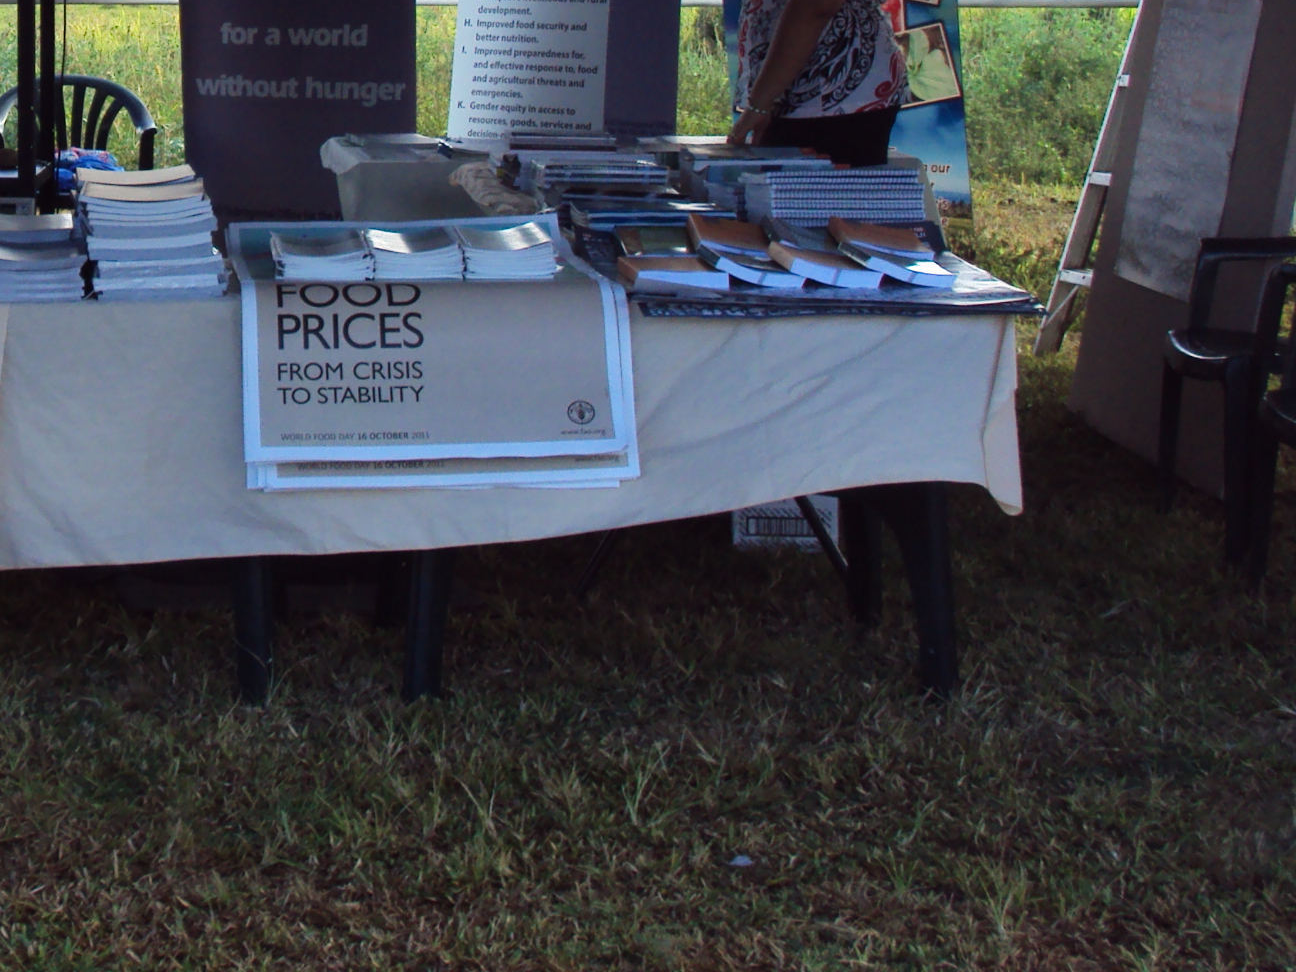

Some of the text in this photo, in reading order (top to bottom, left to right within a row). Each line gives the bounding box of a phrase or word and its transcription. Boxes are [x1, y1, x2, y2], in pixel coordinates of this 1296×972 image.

[478, 6, 532, 17] development.
[464, 19, 587, 32] H. Improved food security and
[220, 22, 368, 47] for a world
[476, 33, 539, 43] better nutrition.
[474, 47, 512, 59] Improved
[514, 48, 569, 62] preparedness
[572, 50, 585, 60] for,
[474, 61, 597, 75] and effective response to, food
[472, 75, 584, 88] and agricultural threats and
[195, 74, 405, 108] without hunger
[471, 88, 523, 99] emergencies.
[457, 101, 575, 115] K. Gender equity in access to
[469, 117, 591, 130] resources, goods, services and
[931, 164, 950, 173] our
[277, 283, 421, 308] FOOD
[277, 312, 424, 350] PRICES
[277, 360, 423, 382] FROM CRISIS
[277, 384, 424, 405] TO STABILITY
[281, 433, 311, 441] WORLD
[313, 433, 336, 441] FOOD
[358, 432, 367, 440] 16
[369, 432, 408, 440] OCTOBER
